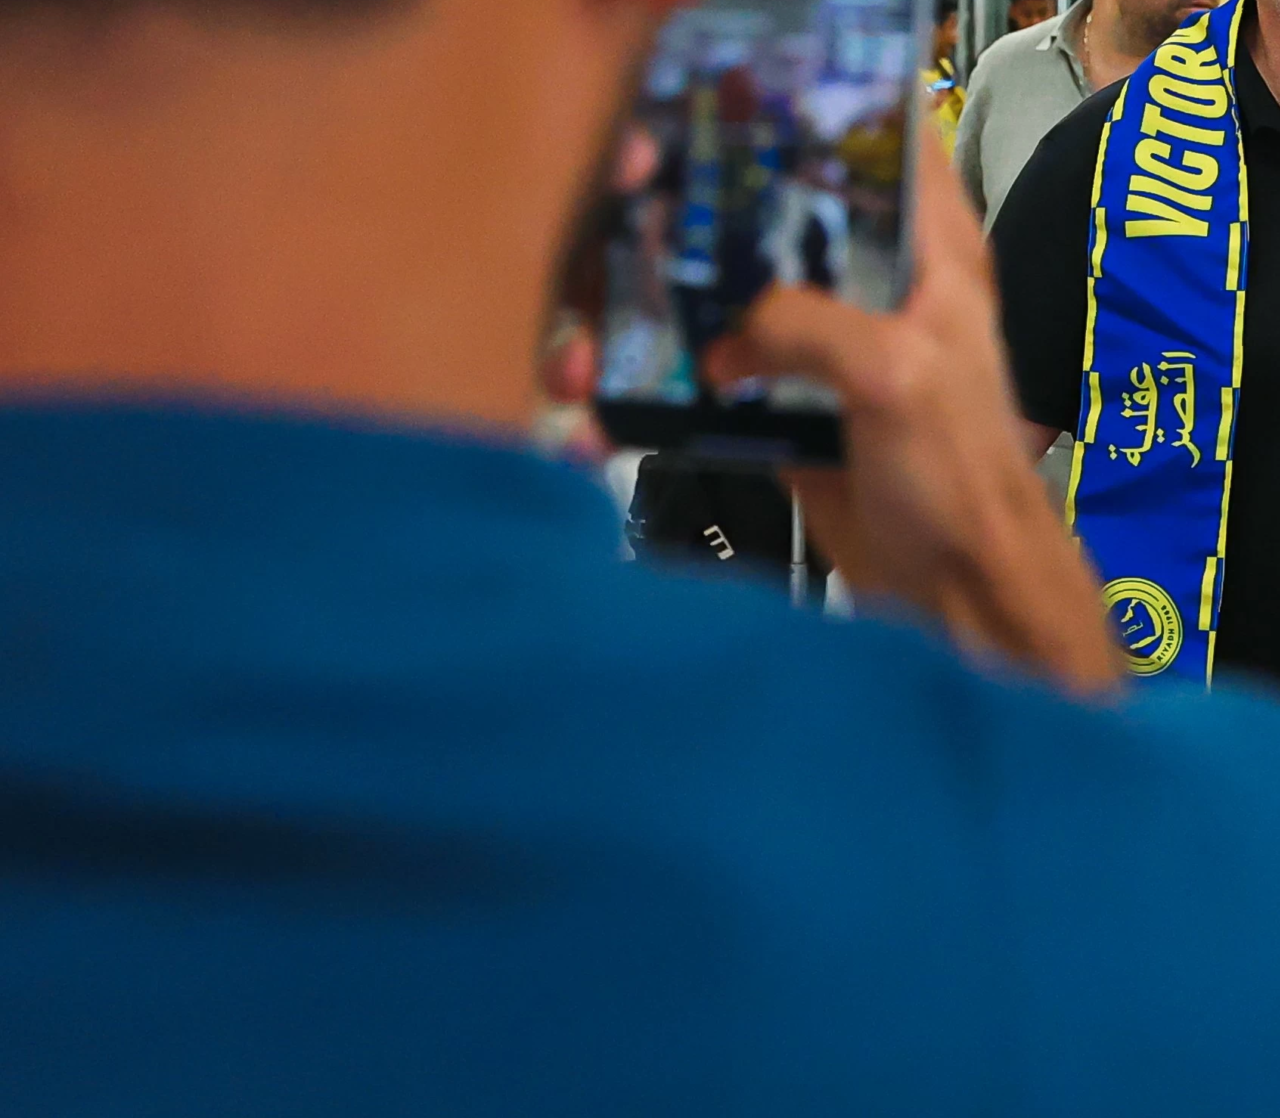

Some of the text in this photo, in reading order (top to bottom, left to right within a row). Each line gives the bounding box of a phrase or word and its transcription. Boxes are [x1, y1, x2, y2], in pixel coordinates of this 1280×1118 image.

[1108, 362, 1165, 467] عقلية
[1157, 351, 1201, 468] النصر
[1156, 628, 1176, 663] RIYADH
